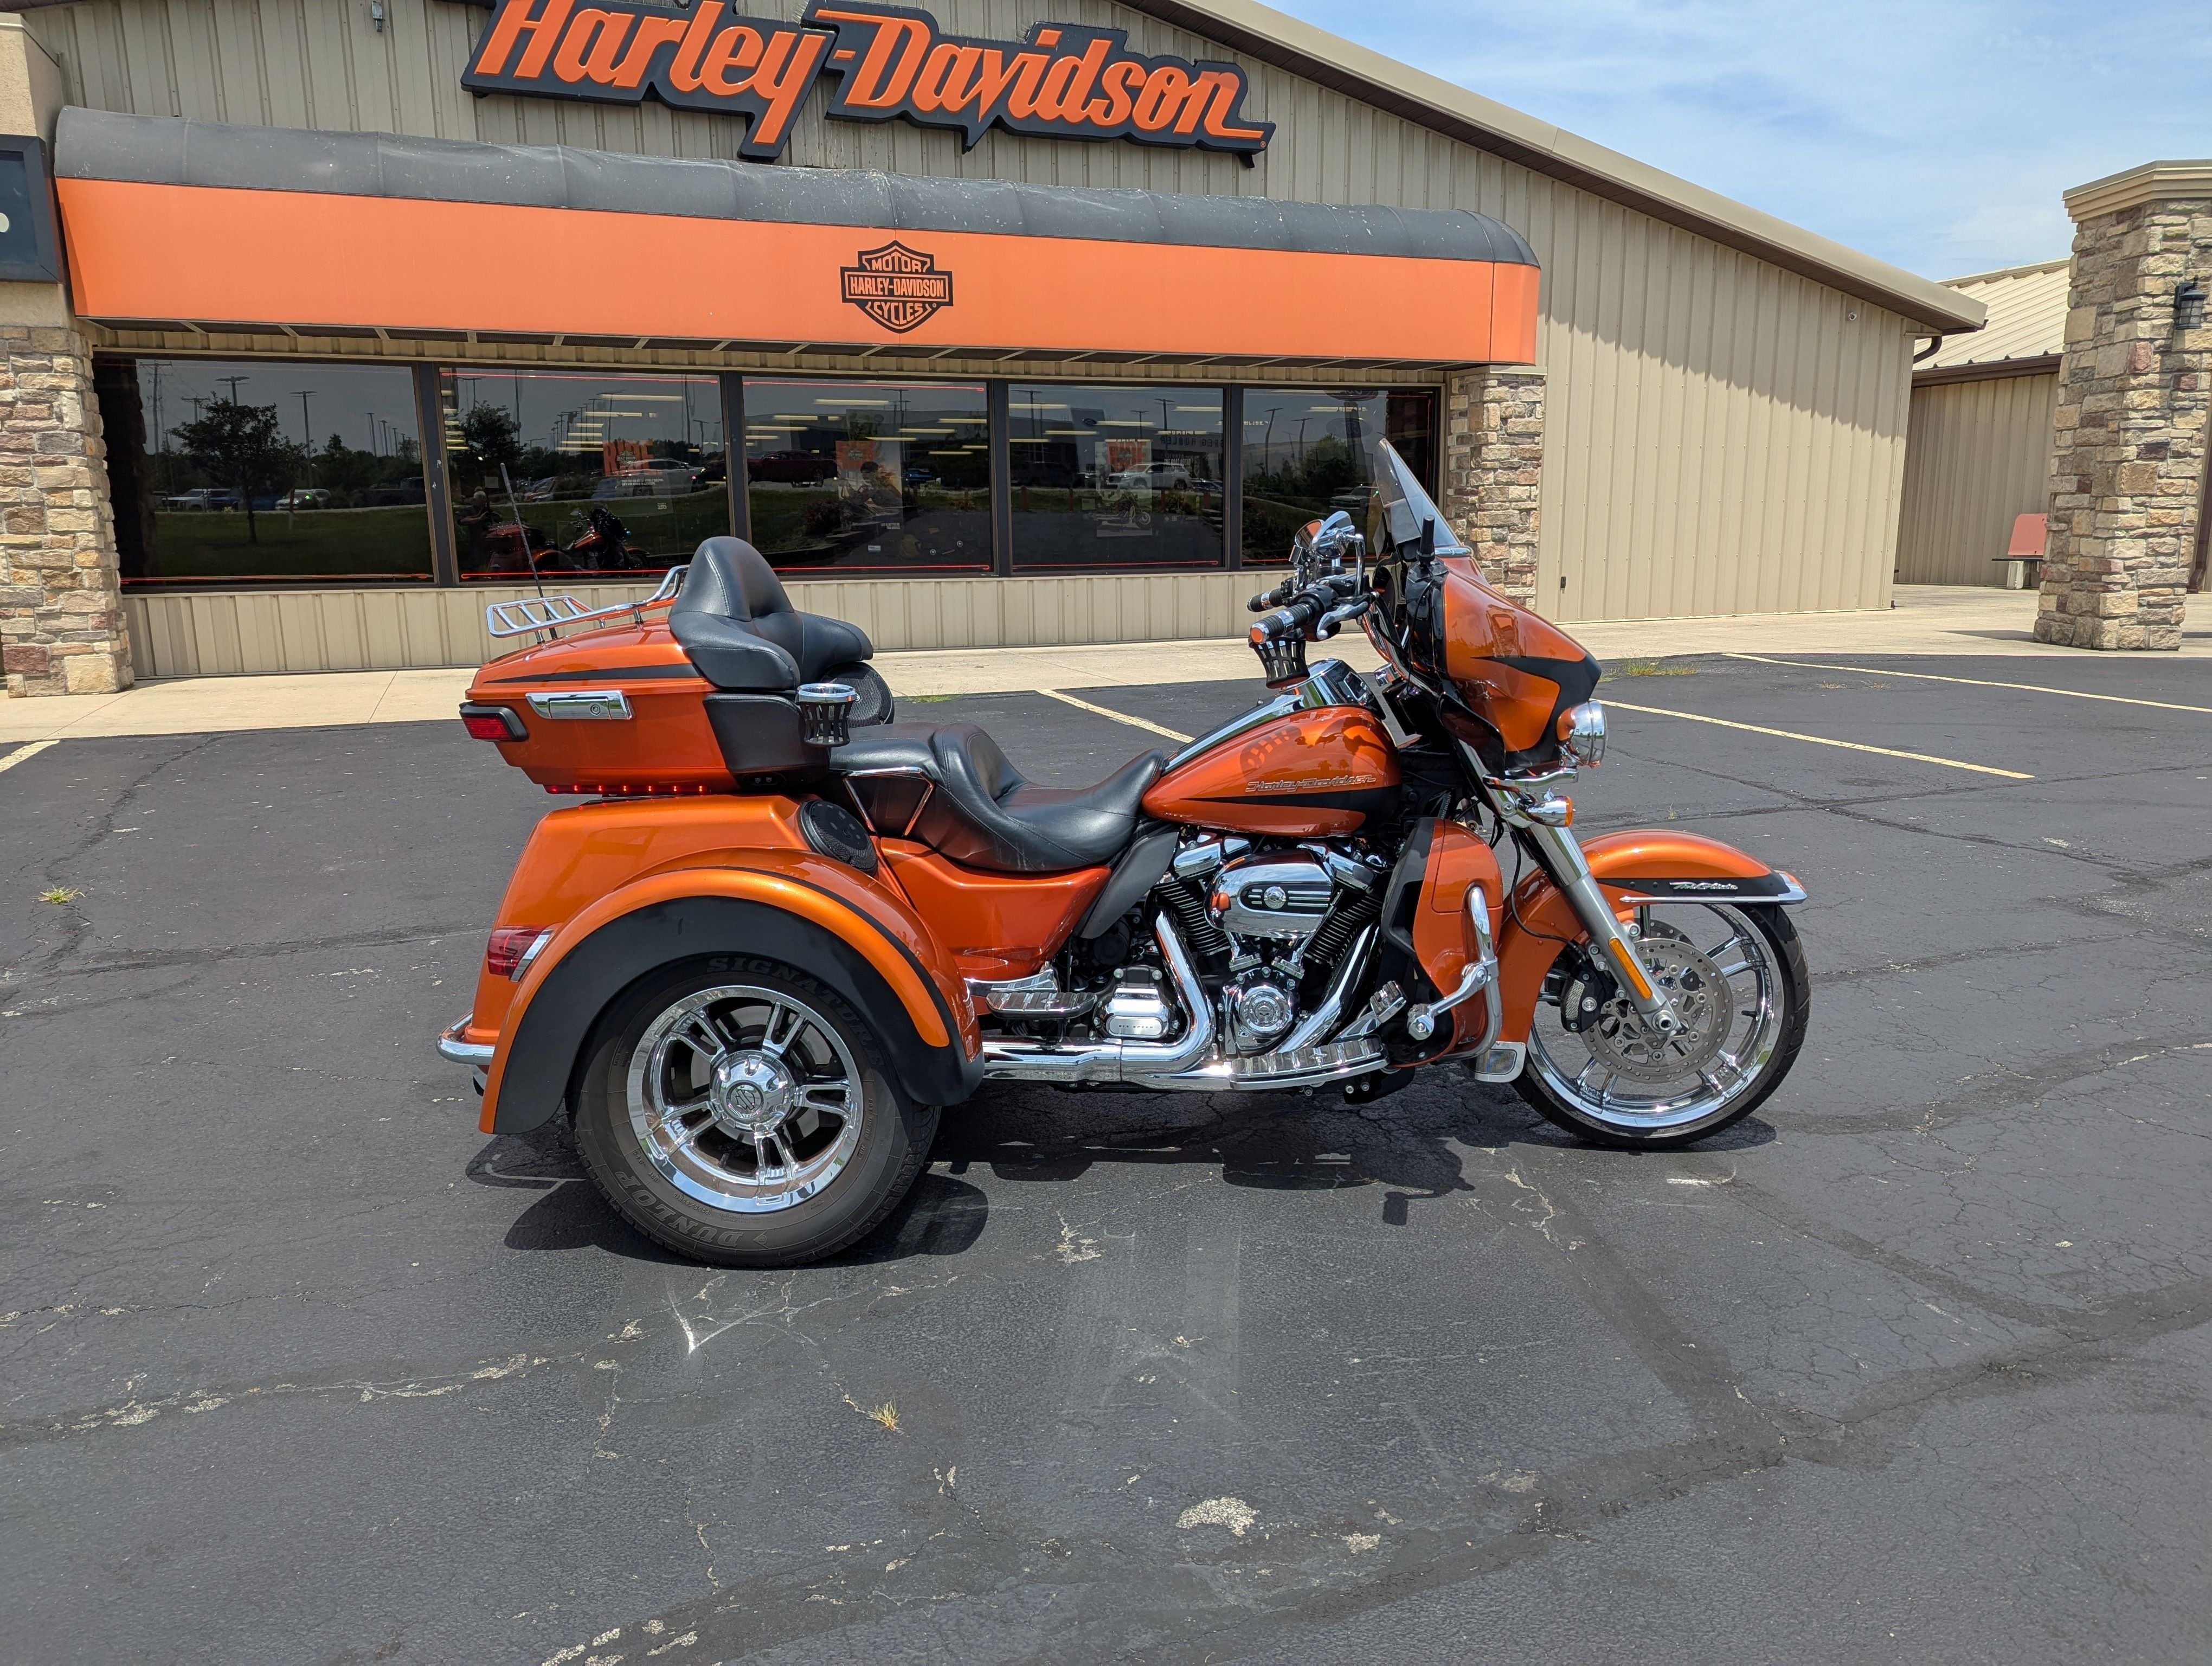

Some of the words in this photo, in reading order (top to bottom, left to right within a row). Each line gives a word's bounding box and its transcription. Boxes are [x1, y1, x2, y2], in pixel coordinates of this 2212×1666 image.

[474, 0, 1262, 145] Harley-Davidson
[871, 252, 921, 272] MOTOR
[850, 276, 944, 297] HARLEY-DAVIDSON
[873, 301, 923, 324] CYCLES
[1245, 774, 1376, 792] Harley-Davidson
[706, 957, 885, 1066] SIGNATURE
[615, 1171, 744, 1247] DUNLOP
